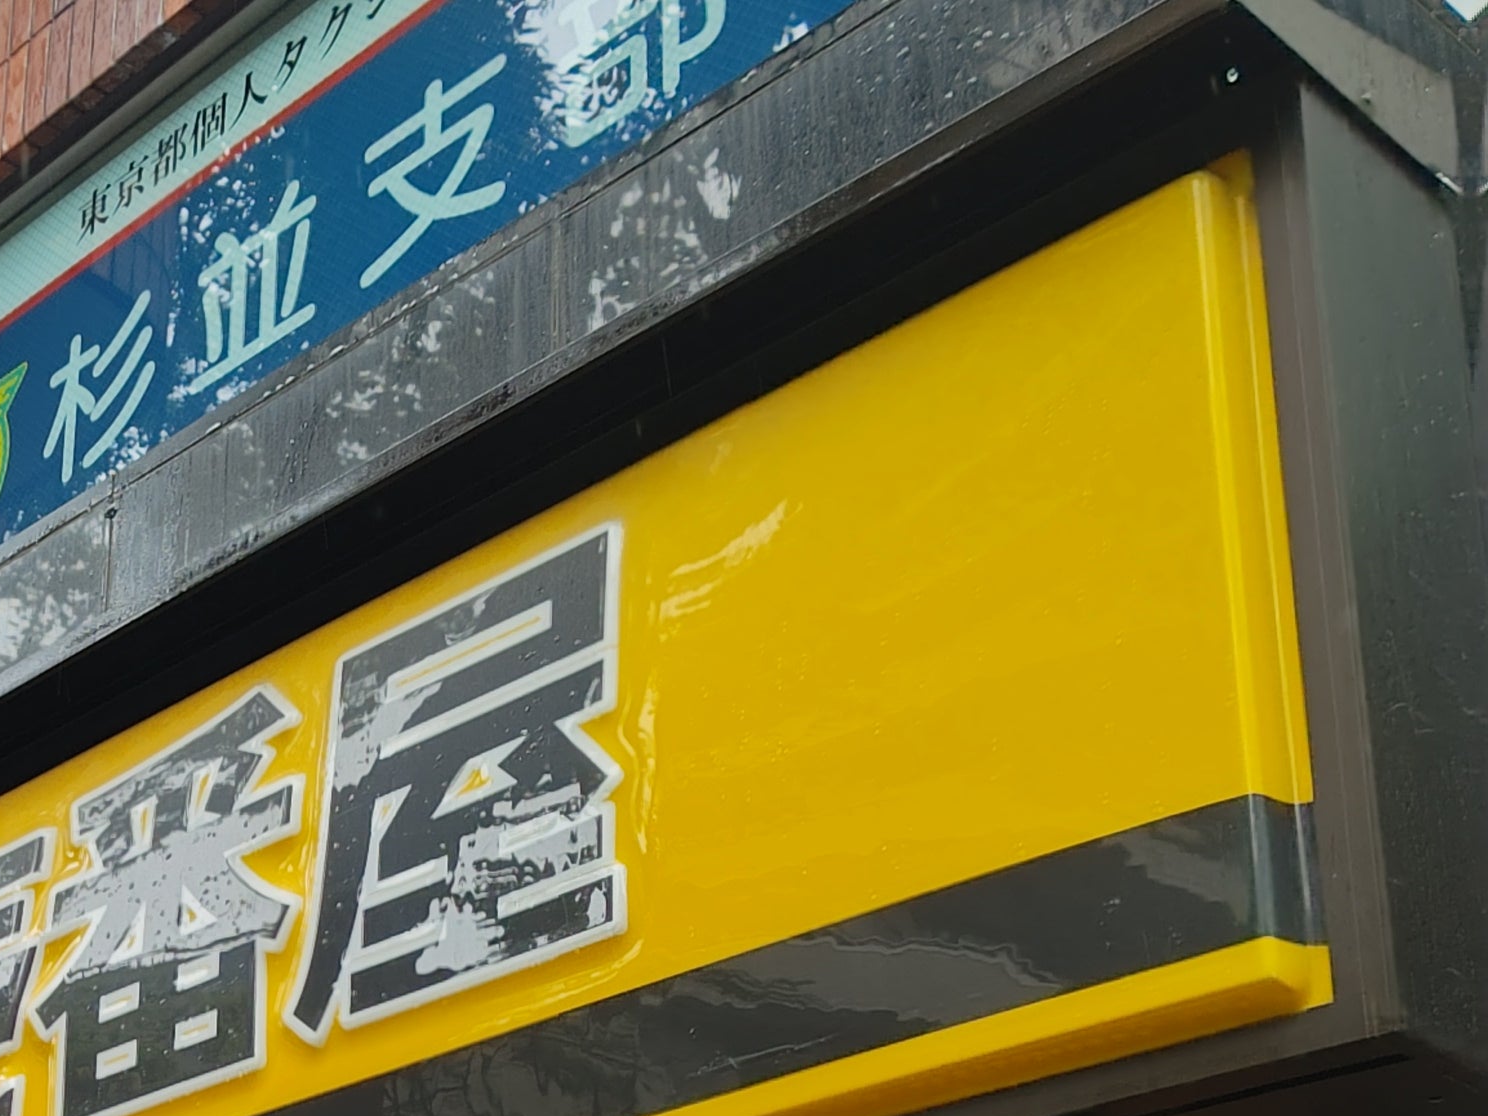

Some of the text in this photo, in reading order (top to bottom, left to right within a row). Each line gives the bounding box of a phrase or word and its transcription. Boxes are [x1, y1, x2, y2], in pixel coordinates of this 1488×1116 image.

[77, 0, 386, 246] 東京都個人タク
